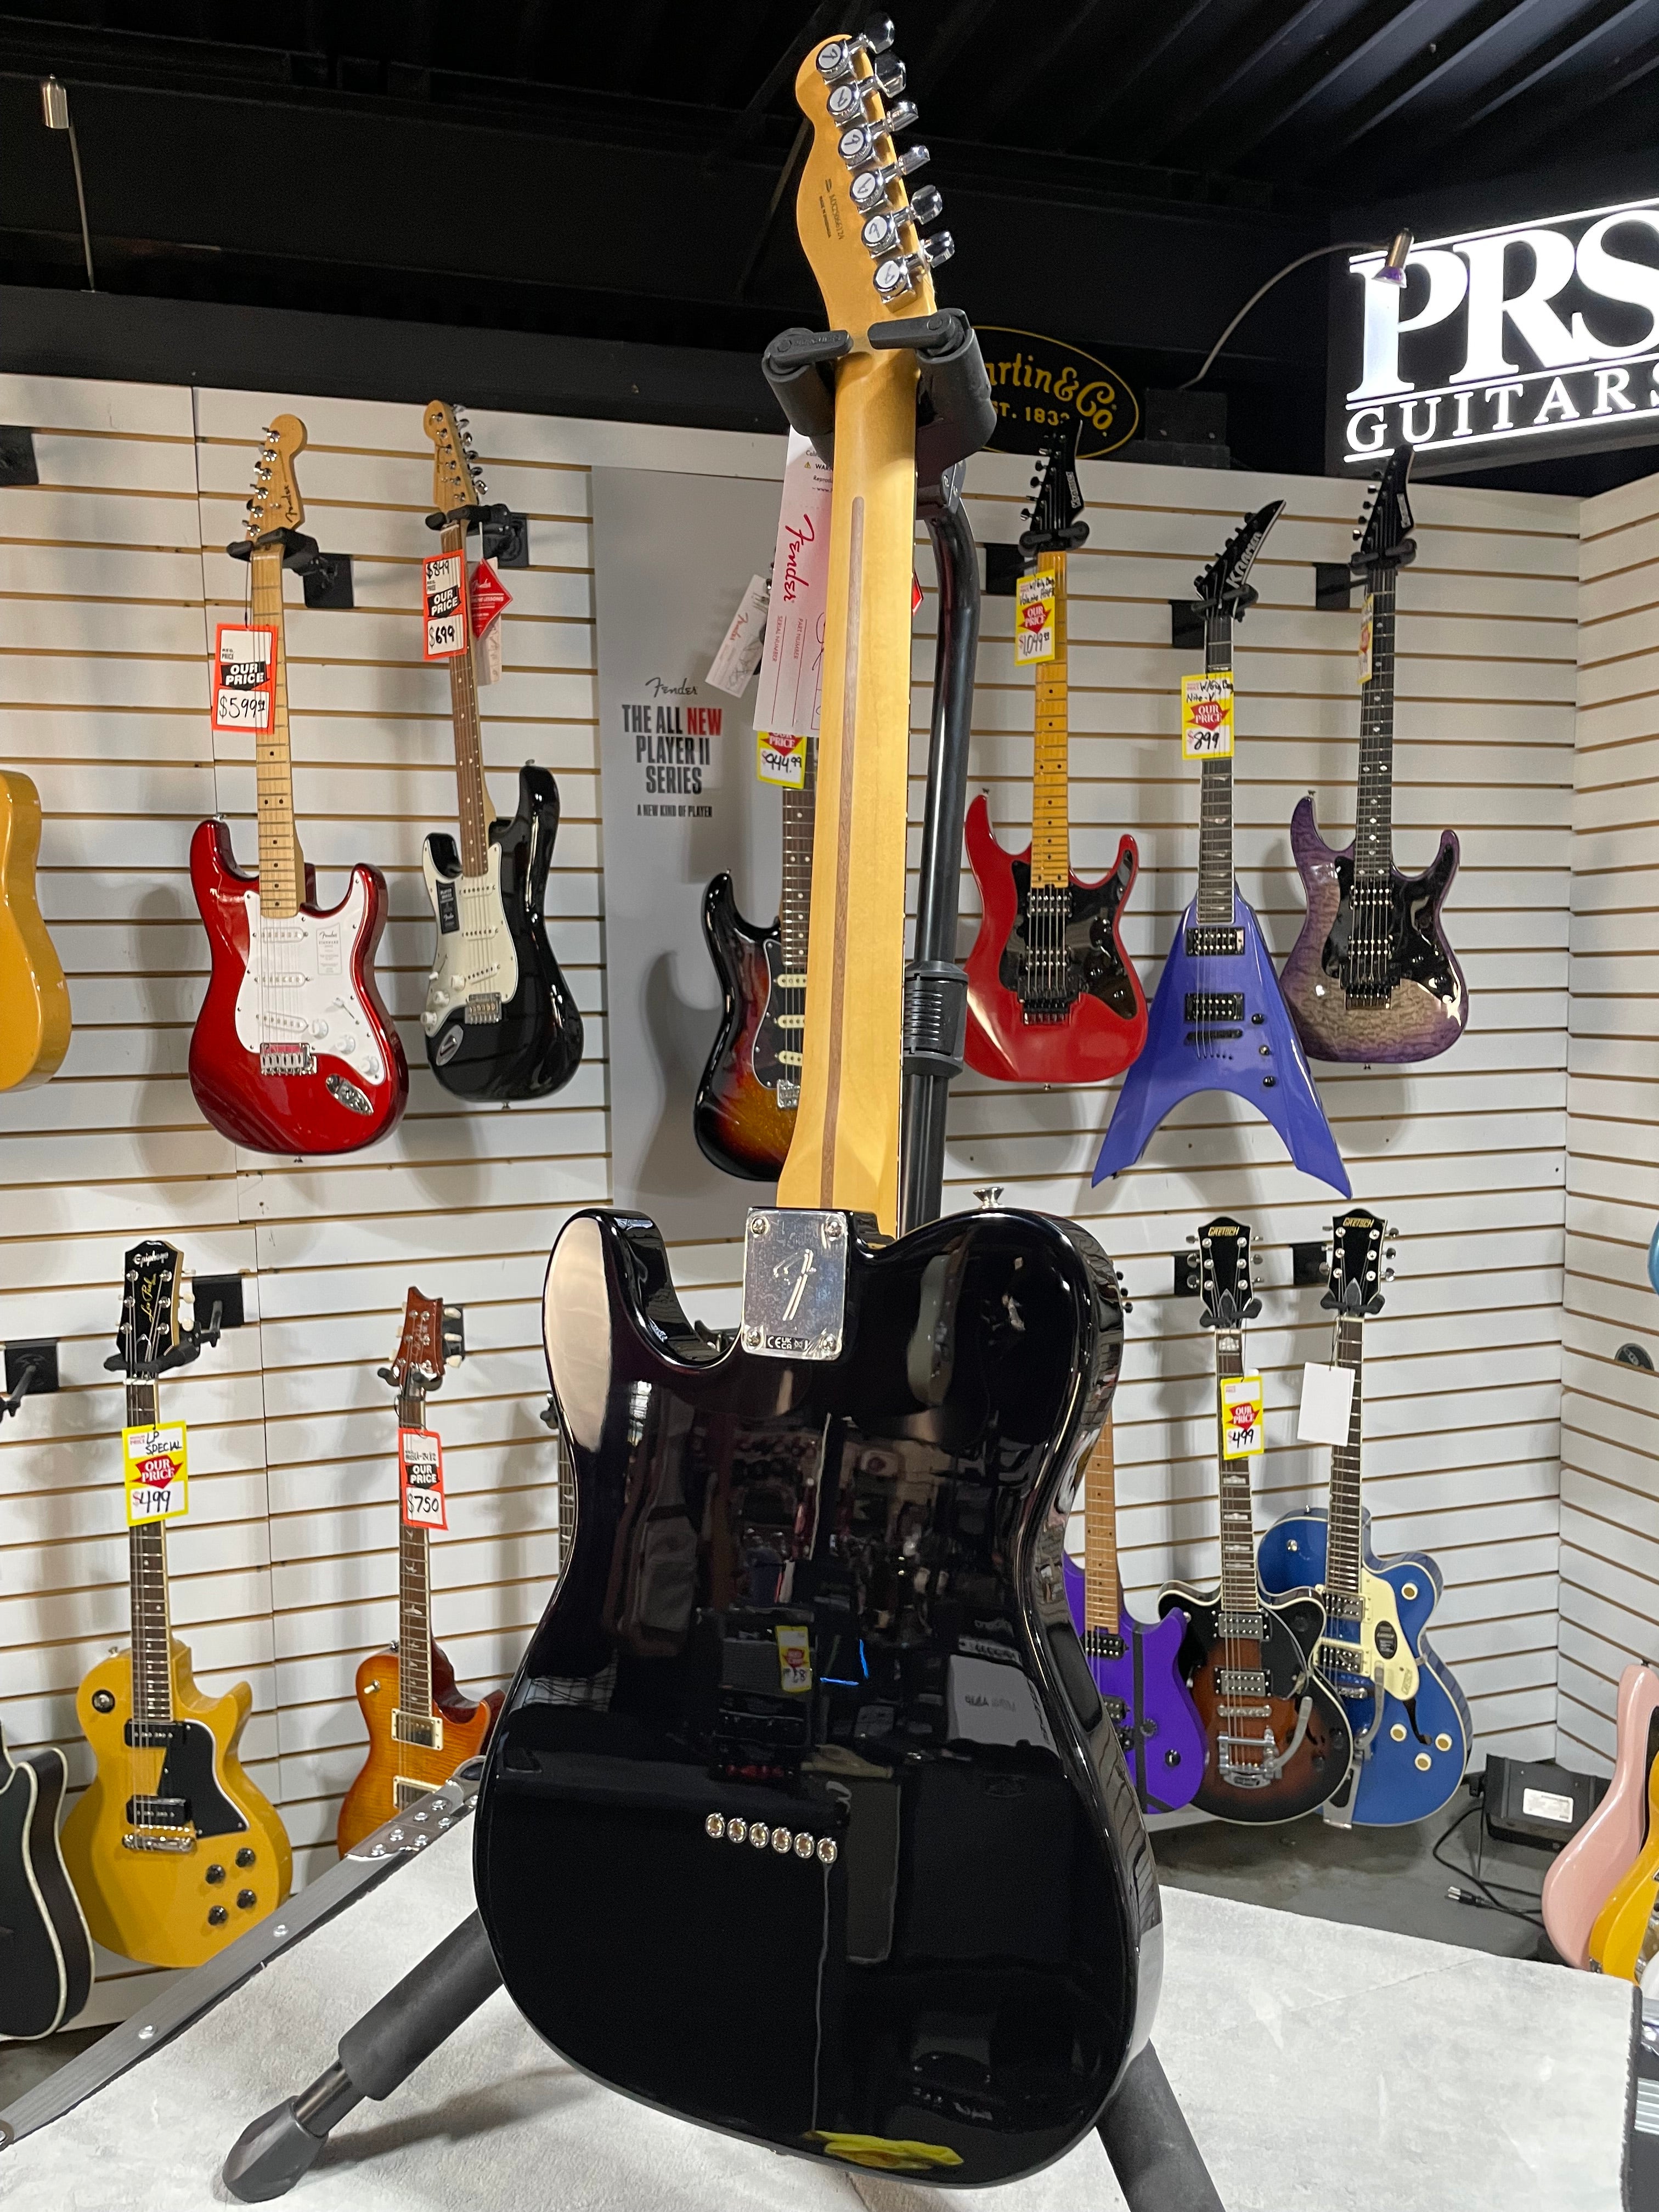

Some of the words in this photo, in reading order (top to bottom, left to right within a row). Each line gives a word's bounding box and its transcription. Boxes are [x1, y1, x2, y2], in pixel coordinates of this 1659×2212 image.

[1346, 208, 1659, 402] PRS
[1346, 366, 1659, 453] GUITAR
[783, 514, 815, 602] Fender
[433, 589, 453, 604] OUR
[431, 598, 458, 616] PRICE
[1028, 606, 1044, 618] OUR
[429, 625, 455, 649] $699
[230, 663, 258, 675] OUR
[225, 673, 264, 686] PRICE
[645, 677, 698, 698] Fender
[1198, 705, 1219, 714] OUR
[622, 704, 652, 733] THE
[657, 706, 683, 734] ALL
[687, 707, 722, 736] NEW
[1195, 713, 1222, 724] PRICE
[769, 736, 795, 748] PRICE
[1187, 730, 1220, 750] $899
[636, 735, 696, 765] PLAYER
[699, 737, 710, 765] II
[646, 766, 702, 795] SERIES
[637, 804, 642, 816] A
[643, 804, 658, 816] NEW
[660, 805, 676, 817] KIND
[678, 805, 686, 817] OF
[688, 805, 712, 818] PLAYER
[132, 1250, 169, 1268] Epiphone
[1233, 1413, 1255, 1425] PRICE
[1235, 1406, 1252, 1417] OUR
[146, 1431, 160, 1444] LP
[1228, 1428, 1254, 1449] $499
[145, 1458, 171, 1472] OUR
[413, 1465, 432, 1475] OUR
[142, 1468, 176, 1482] PRICE
[410, 1474, 437, 1484] PRICE
[132, 1490, 171, 1513] $499
[407, 1492, 439, 1514] $750
